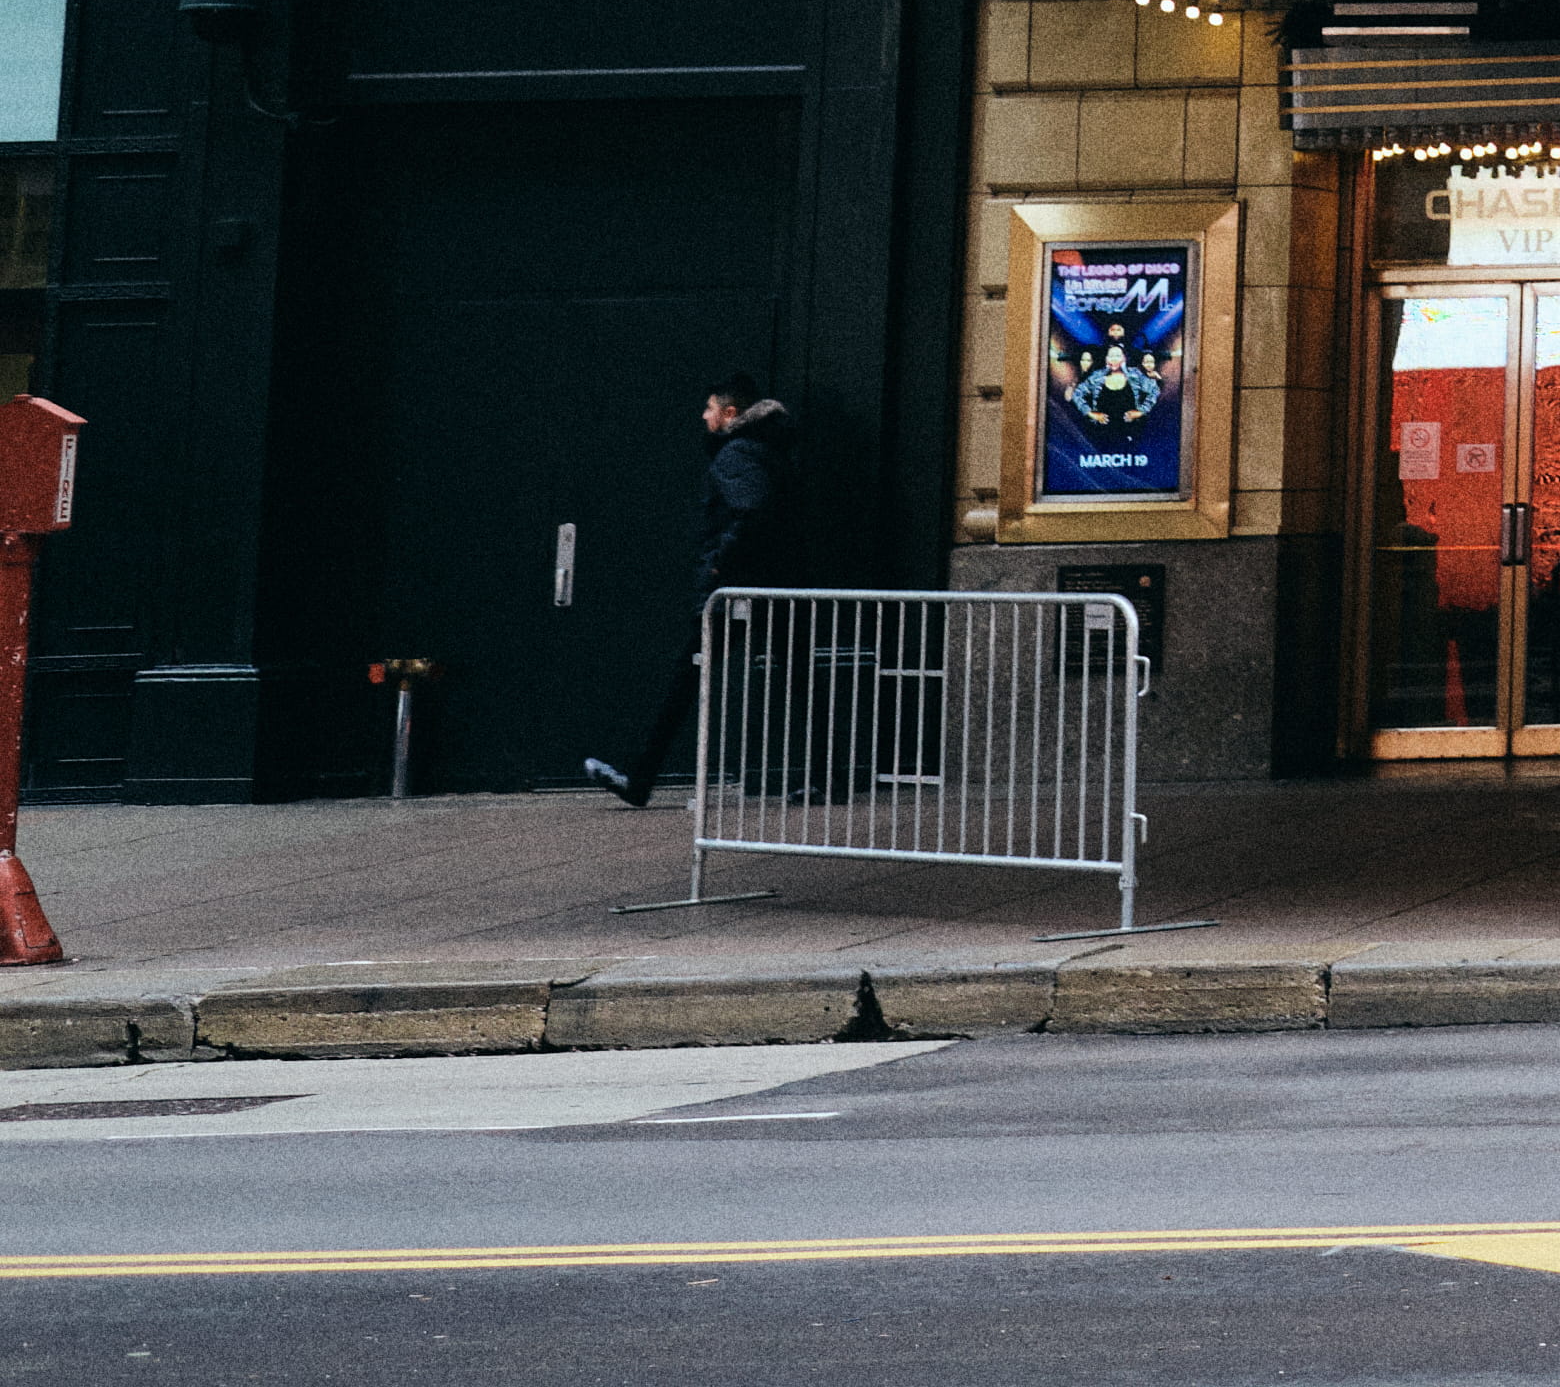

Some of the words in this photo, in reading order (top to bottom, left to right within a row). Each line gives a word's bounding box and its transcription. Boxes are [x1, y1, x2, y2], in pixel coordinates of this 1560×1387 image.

[1498, 228, 1554, 253] VIP
[1058, 265, 1081, 277] THE
[1145, 263, 1180, 274] DISCO
[1080, 454, 1133, 468] MARCH
[1134, 455, 1148, 467] 19
[60, 438, 74, 519] FIRE
